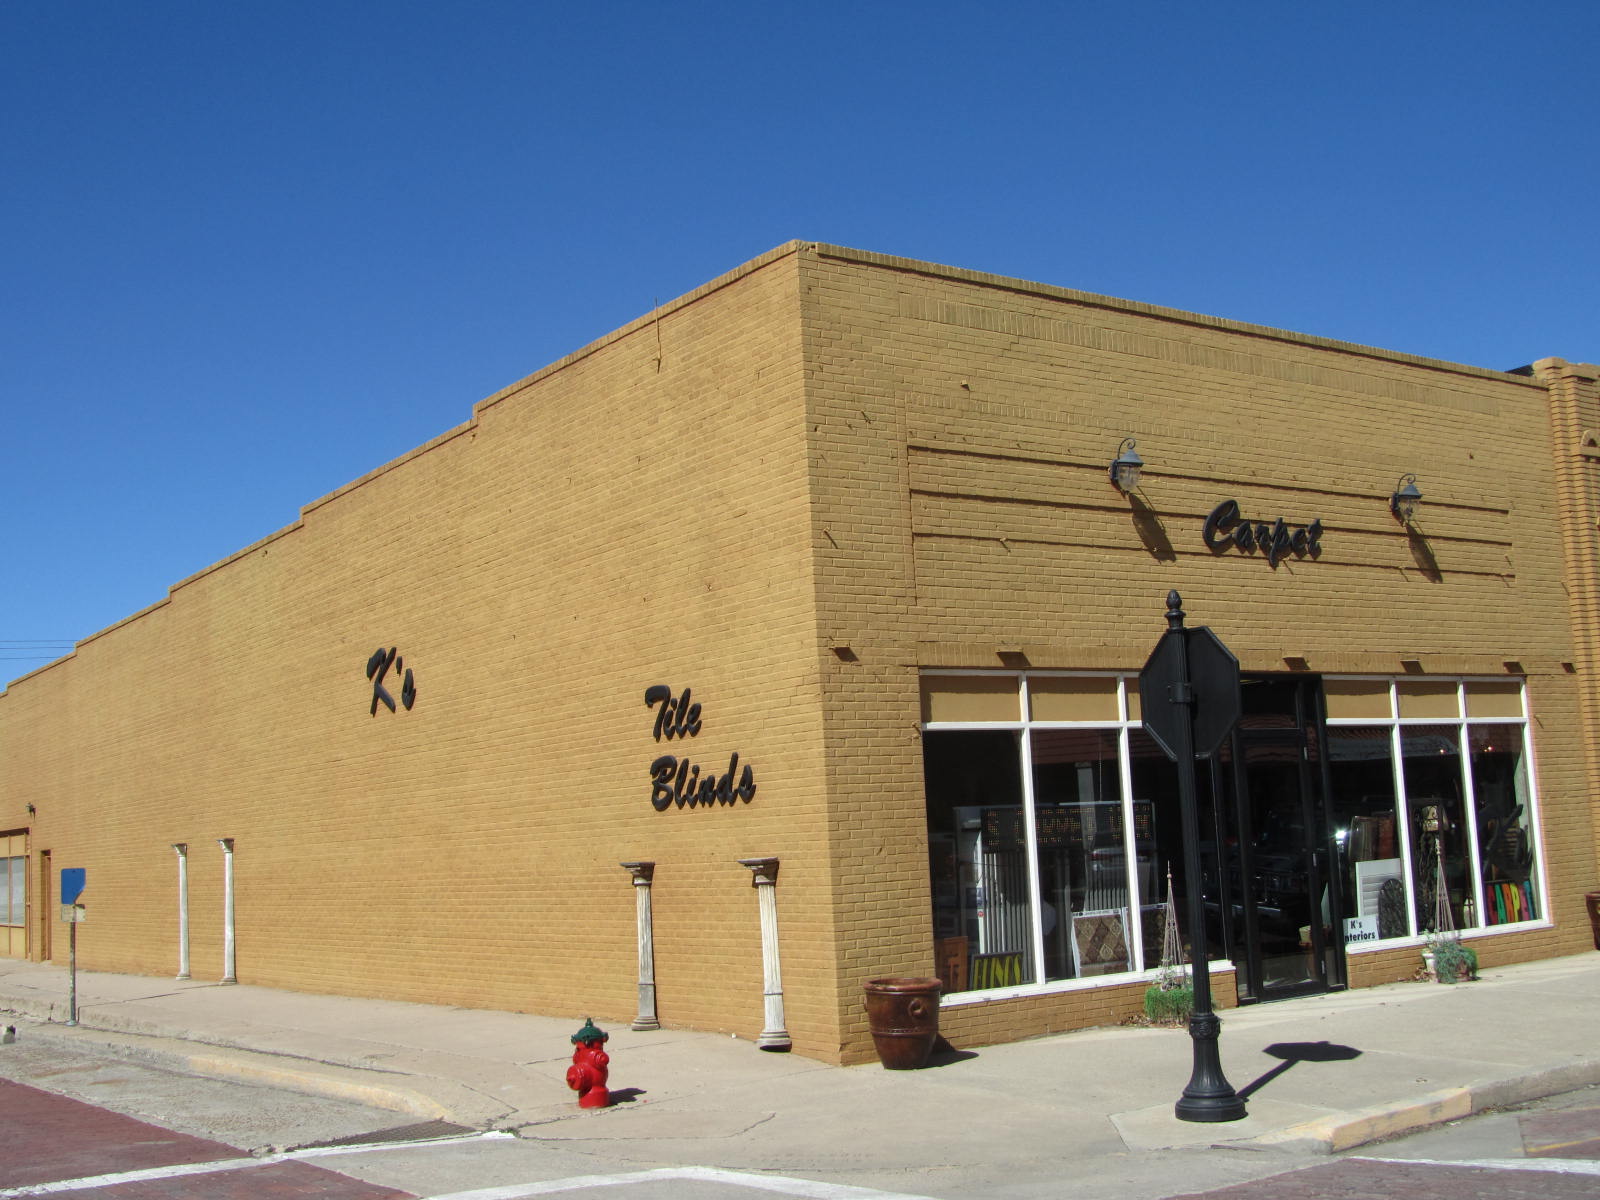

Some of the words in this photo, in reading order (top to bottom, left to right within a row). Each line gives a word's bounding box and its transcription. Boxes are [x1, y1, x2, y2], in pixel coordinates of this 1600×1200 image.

[1202, 499, 1322, 571] Carpet
[366, 646, 417, 718] K's
[644, 684, 702, 743] Tile
[649, 751, 757, 812] Blinds
[1487, 880, 1535, 925] CARPET
[1344, 930, 1376, 942] nteriors
